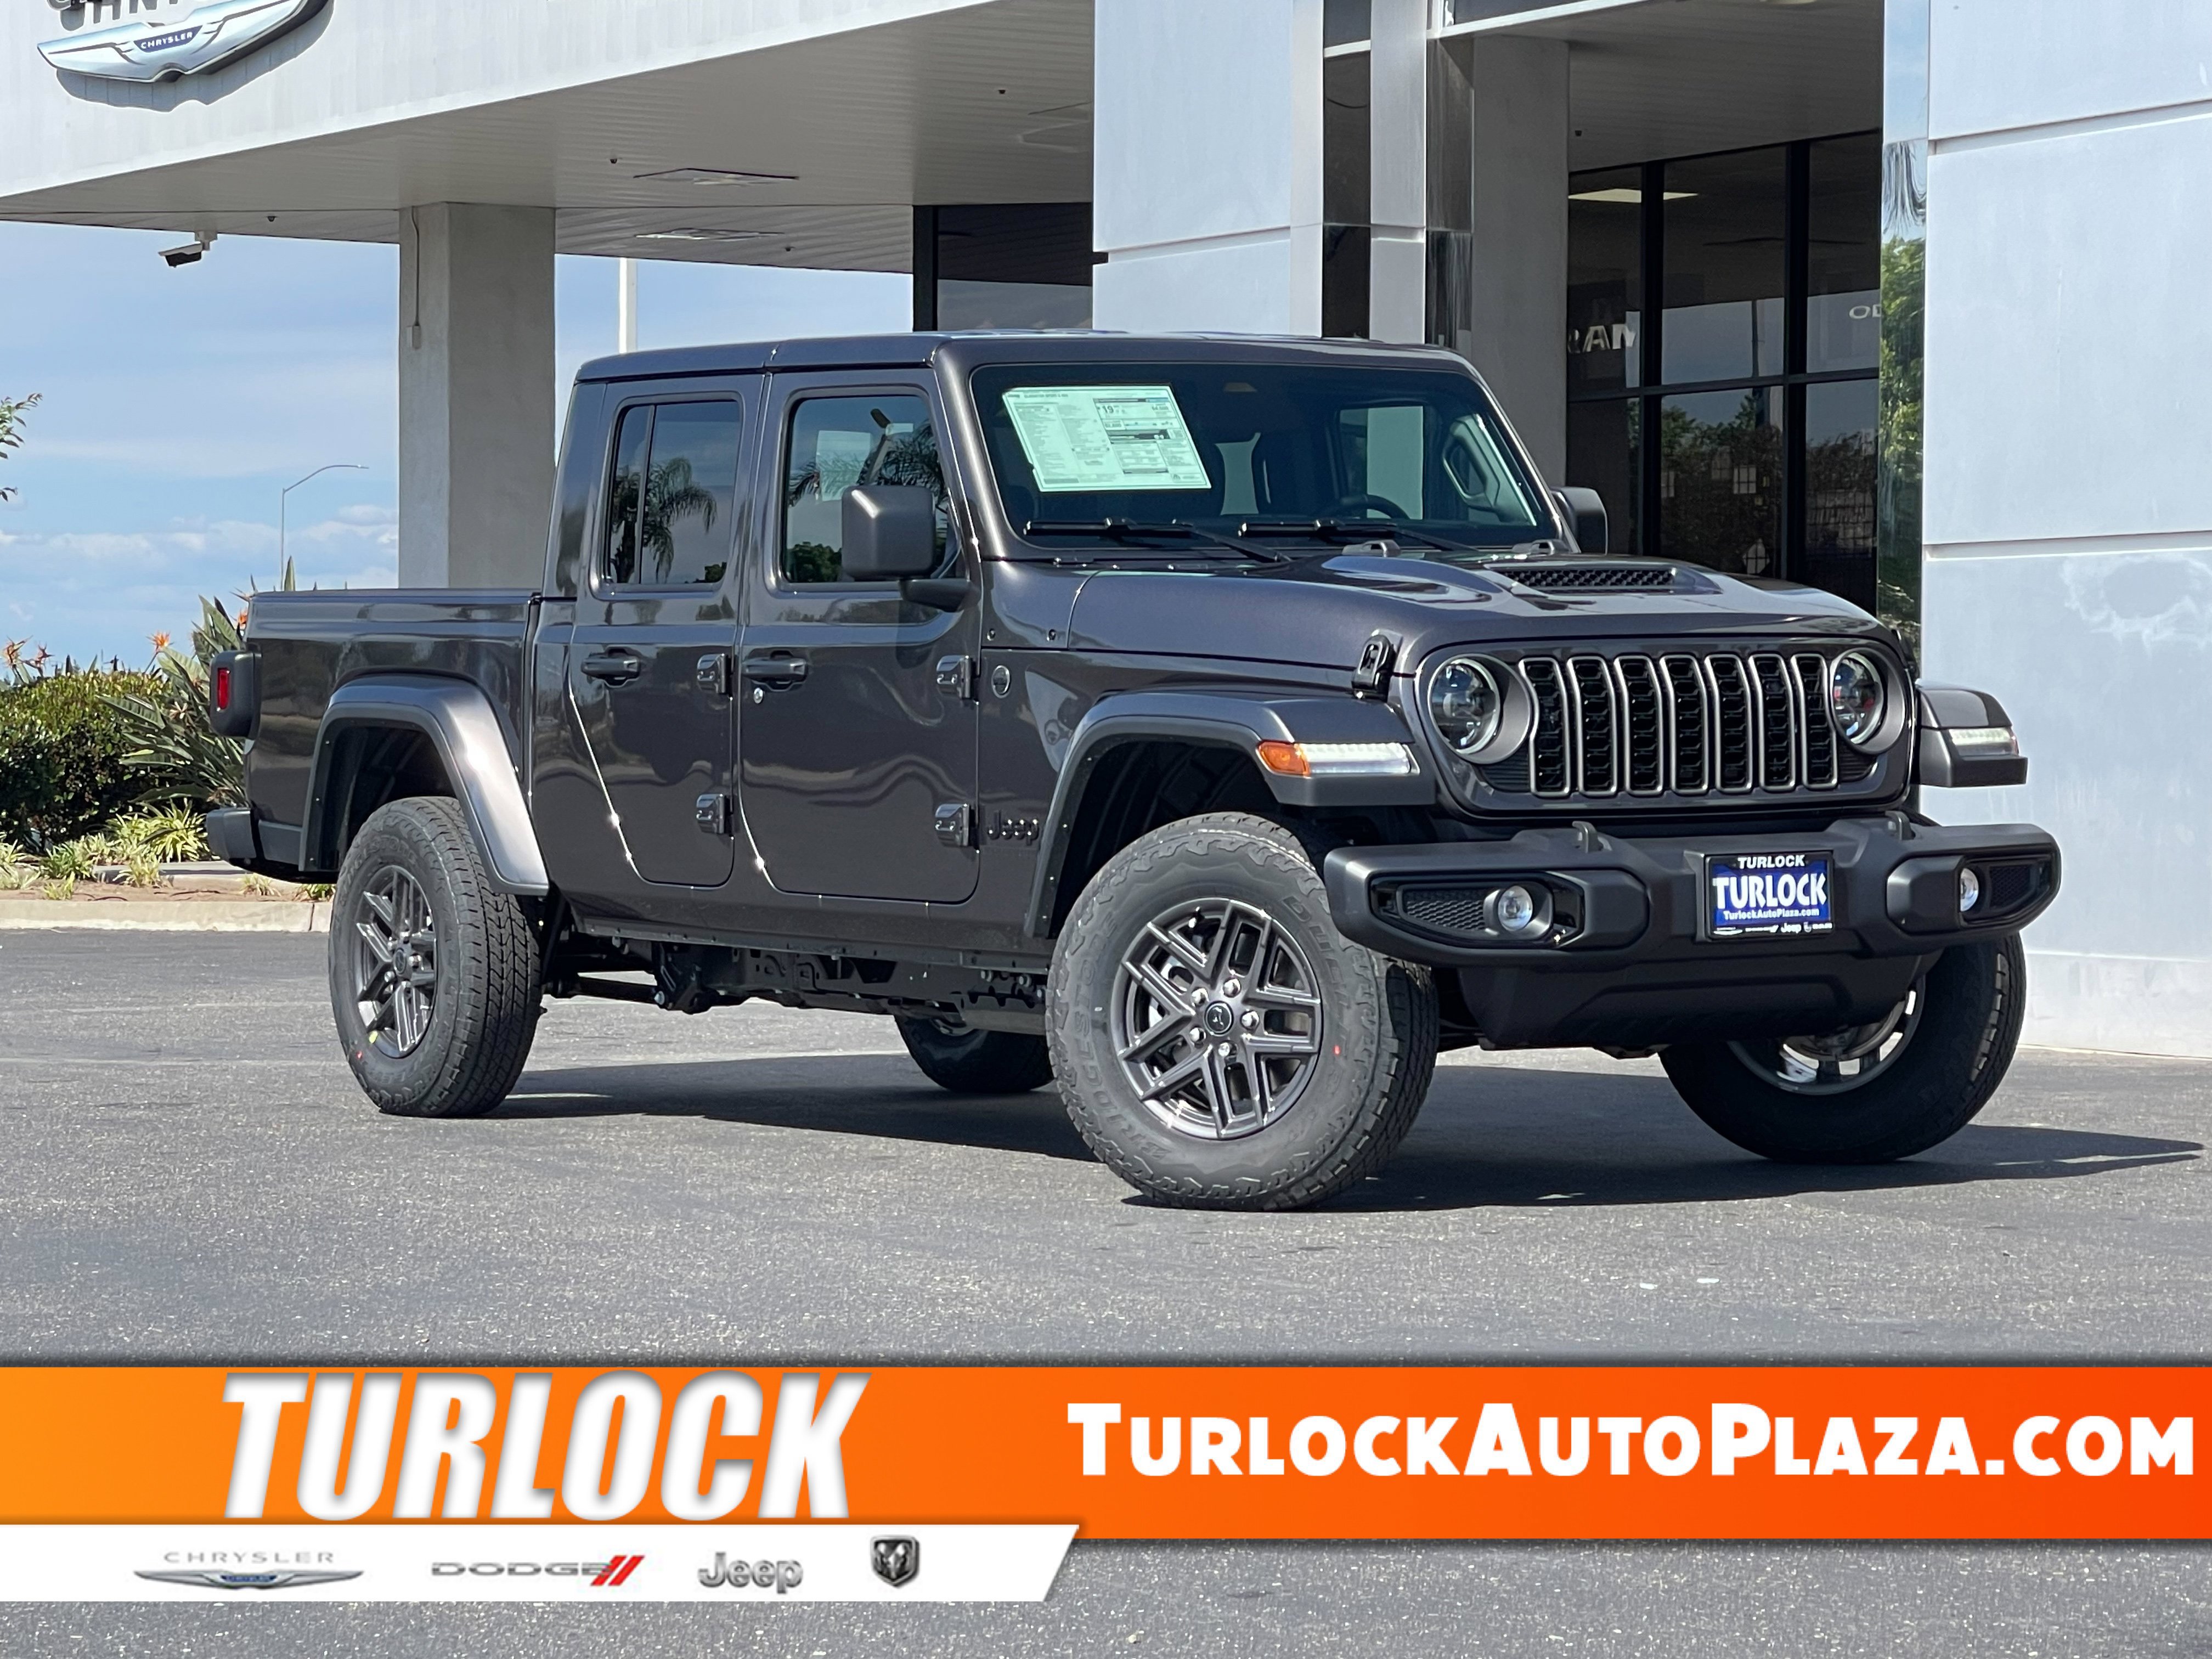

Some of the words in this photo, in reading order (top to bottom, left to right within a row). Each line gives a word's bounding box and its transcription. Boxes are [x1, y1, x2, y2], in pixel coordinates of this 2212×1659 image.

[140, 31, 193, 50] CHRYSLER
[988, 810, 1039, 846] Jeep
[1737, 854, 1805, 869] TURLOCK
[1712, 872, 1827, 910] TURLOCK
[1723, 908, 1820, 920] TurlockAutoPlaza.com
